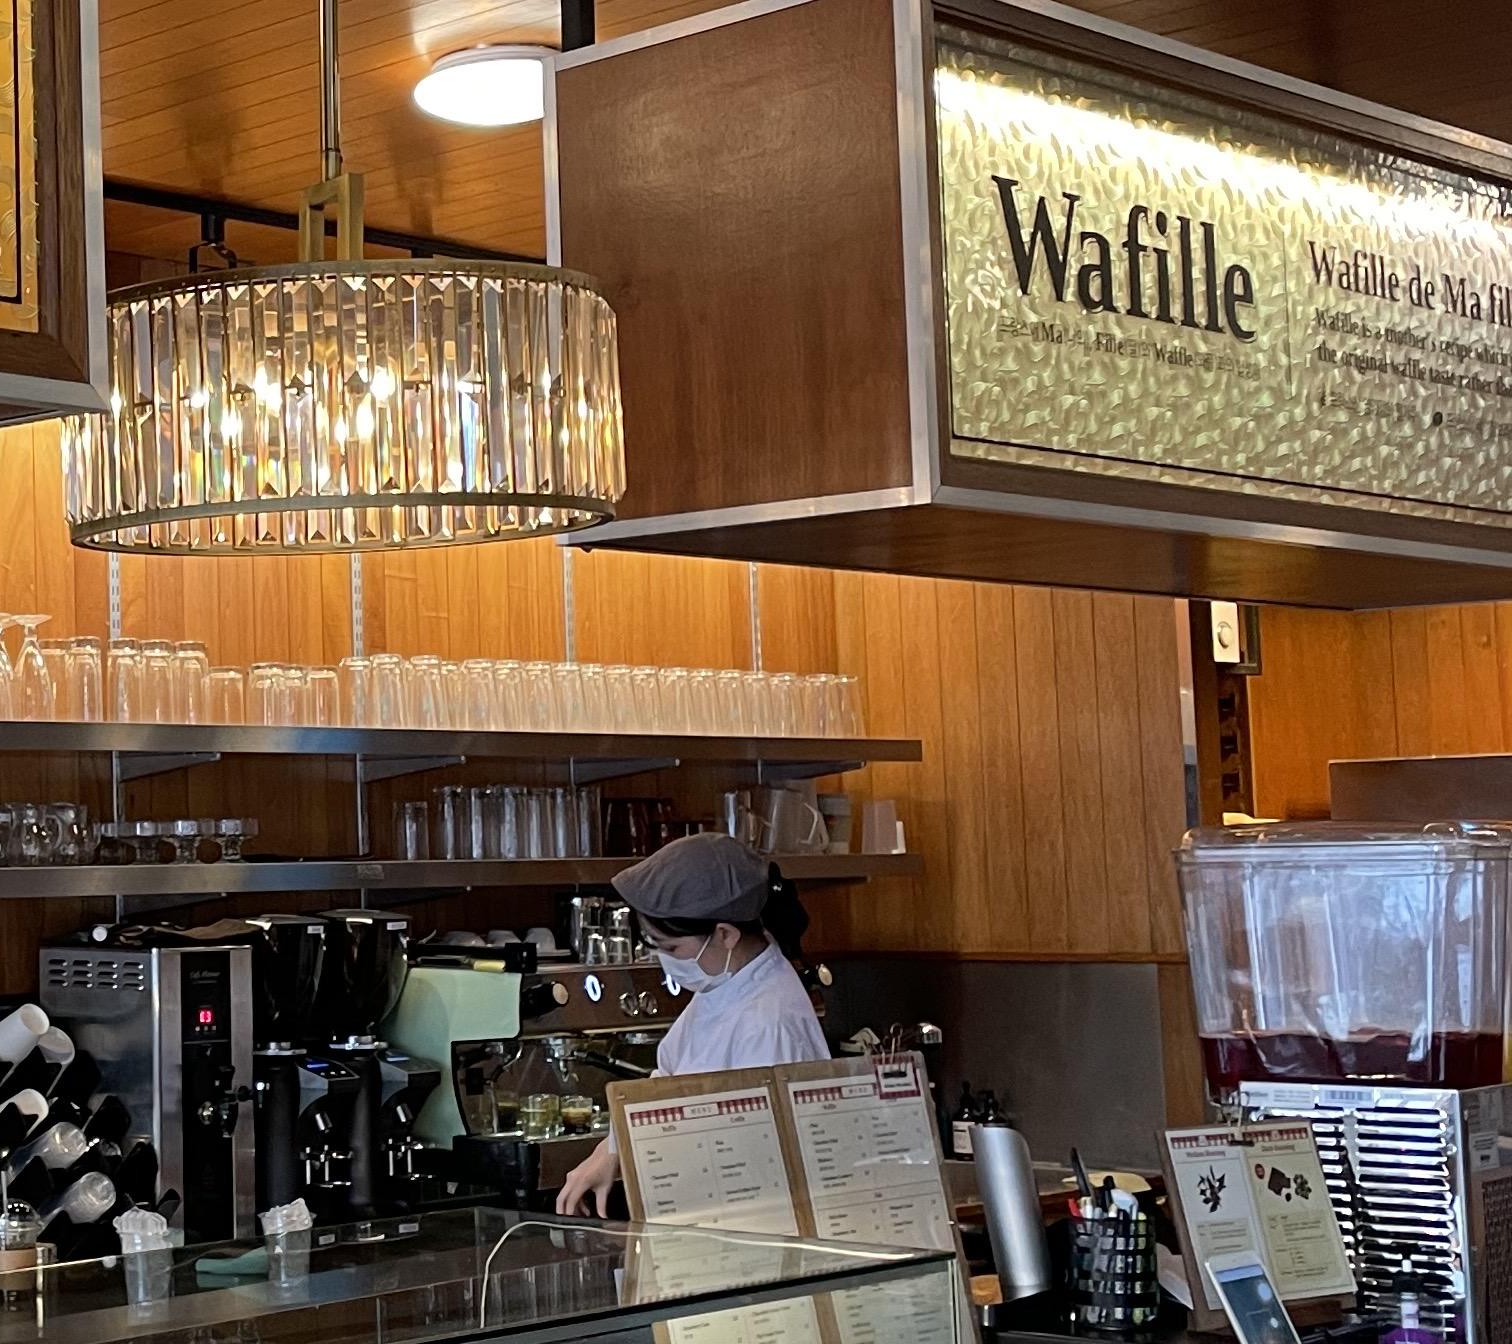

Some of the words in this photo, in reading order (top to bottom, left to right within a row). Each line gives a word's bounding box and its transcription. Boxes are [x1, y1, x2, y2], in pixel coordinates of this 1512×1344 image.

[991, 174, 1258, 344] Wafille
[1308, 240, 1401, 303] Wafille
[1408, 263, 1436, 311] de
[1441, 272, 1484, 322] Ma
